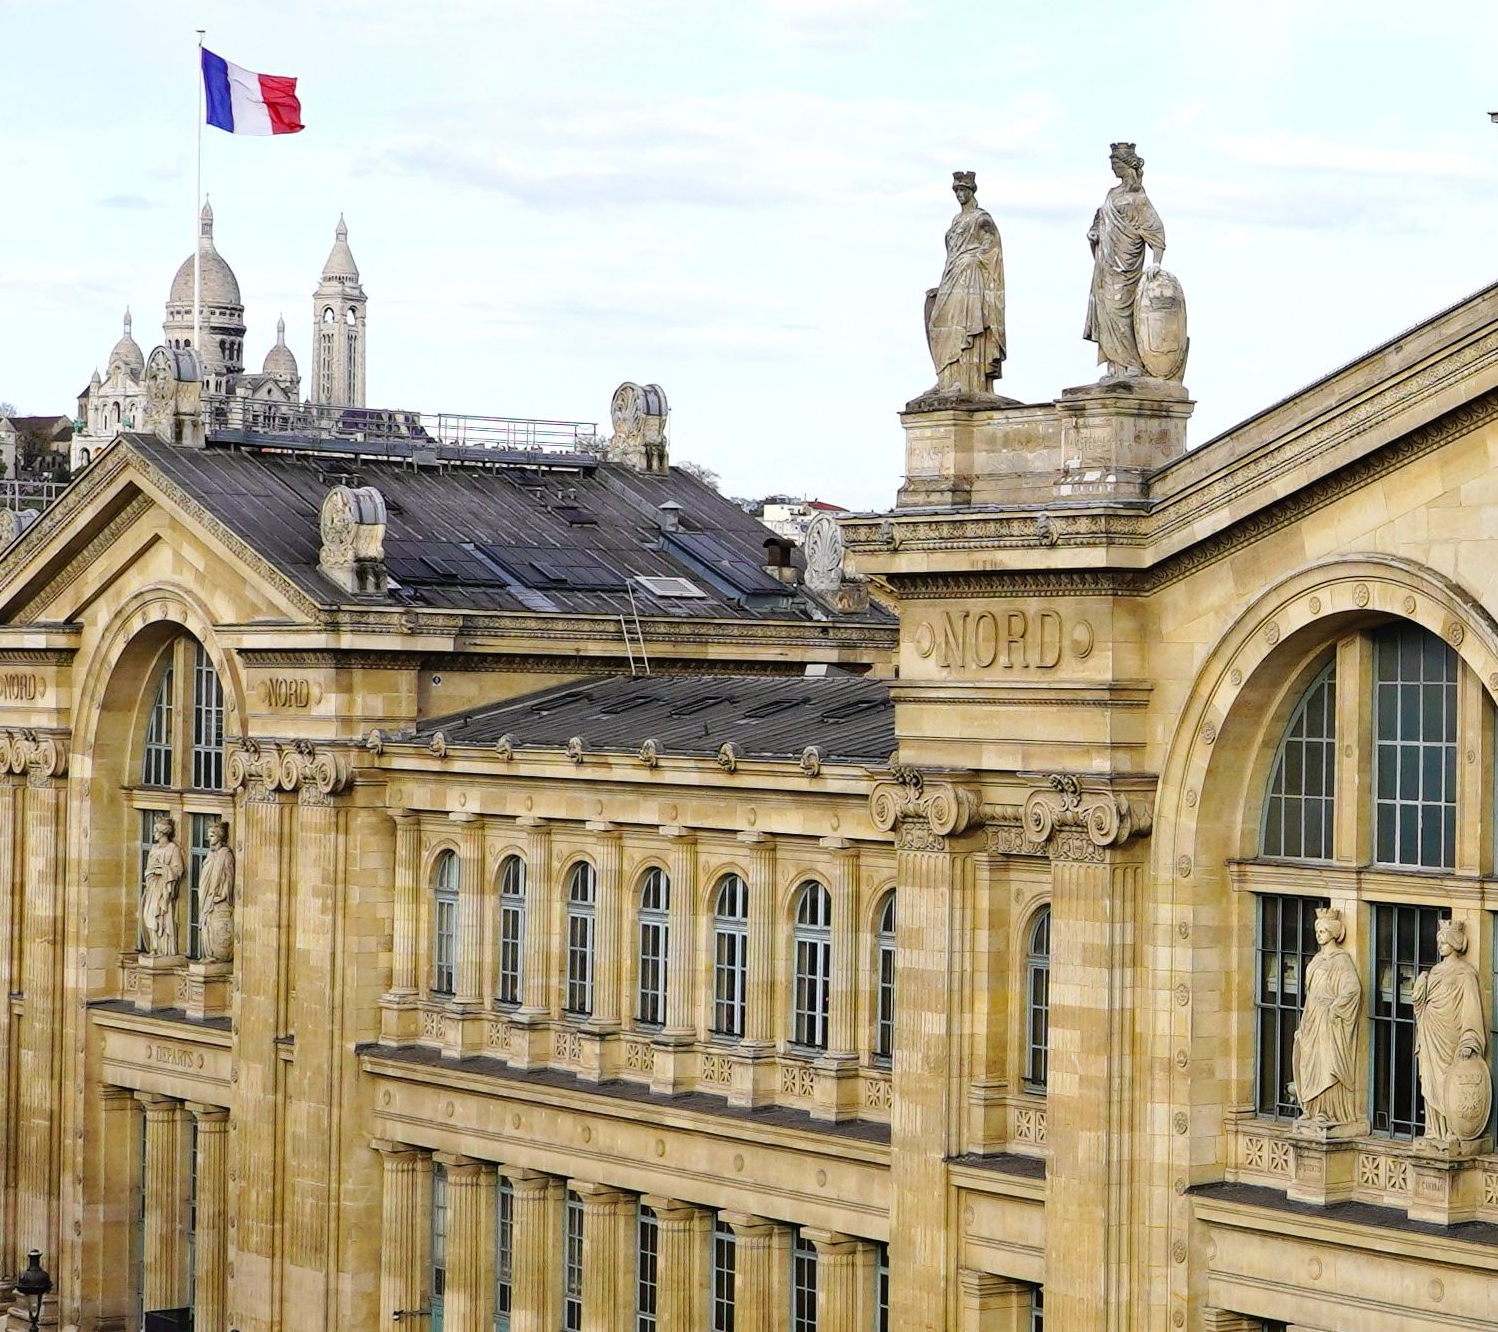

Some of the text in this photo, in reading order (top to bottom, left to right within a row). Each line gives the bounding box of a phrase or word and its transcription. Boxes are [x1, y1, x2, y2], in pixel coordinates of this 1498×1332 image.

[941, 610, 1063, 669] NORD
[5, 674, 36, 700] NORD
[268, 678, 309, 708] NORD
